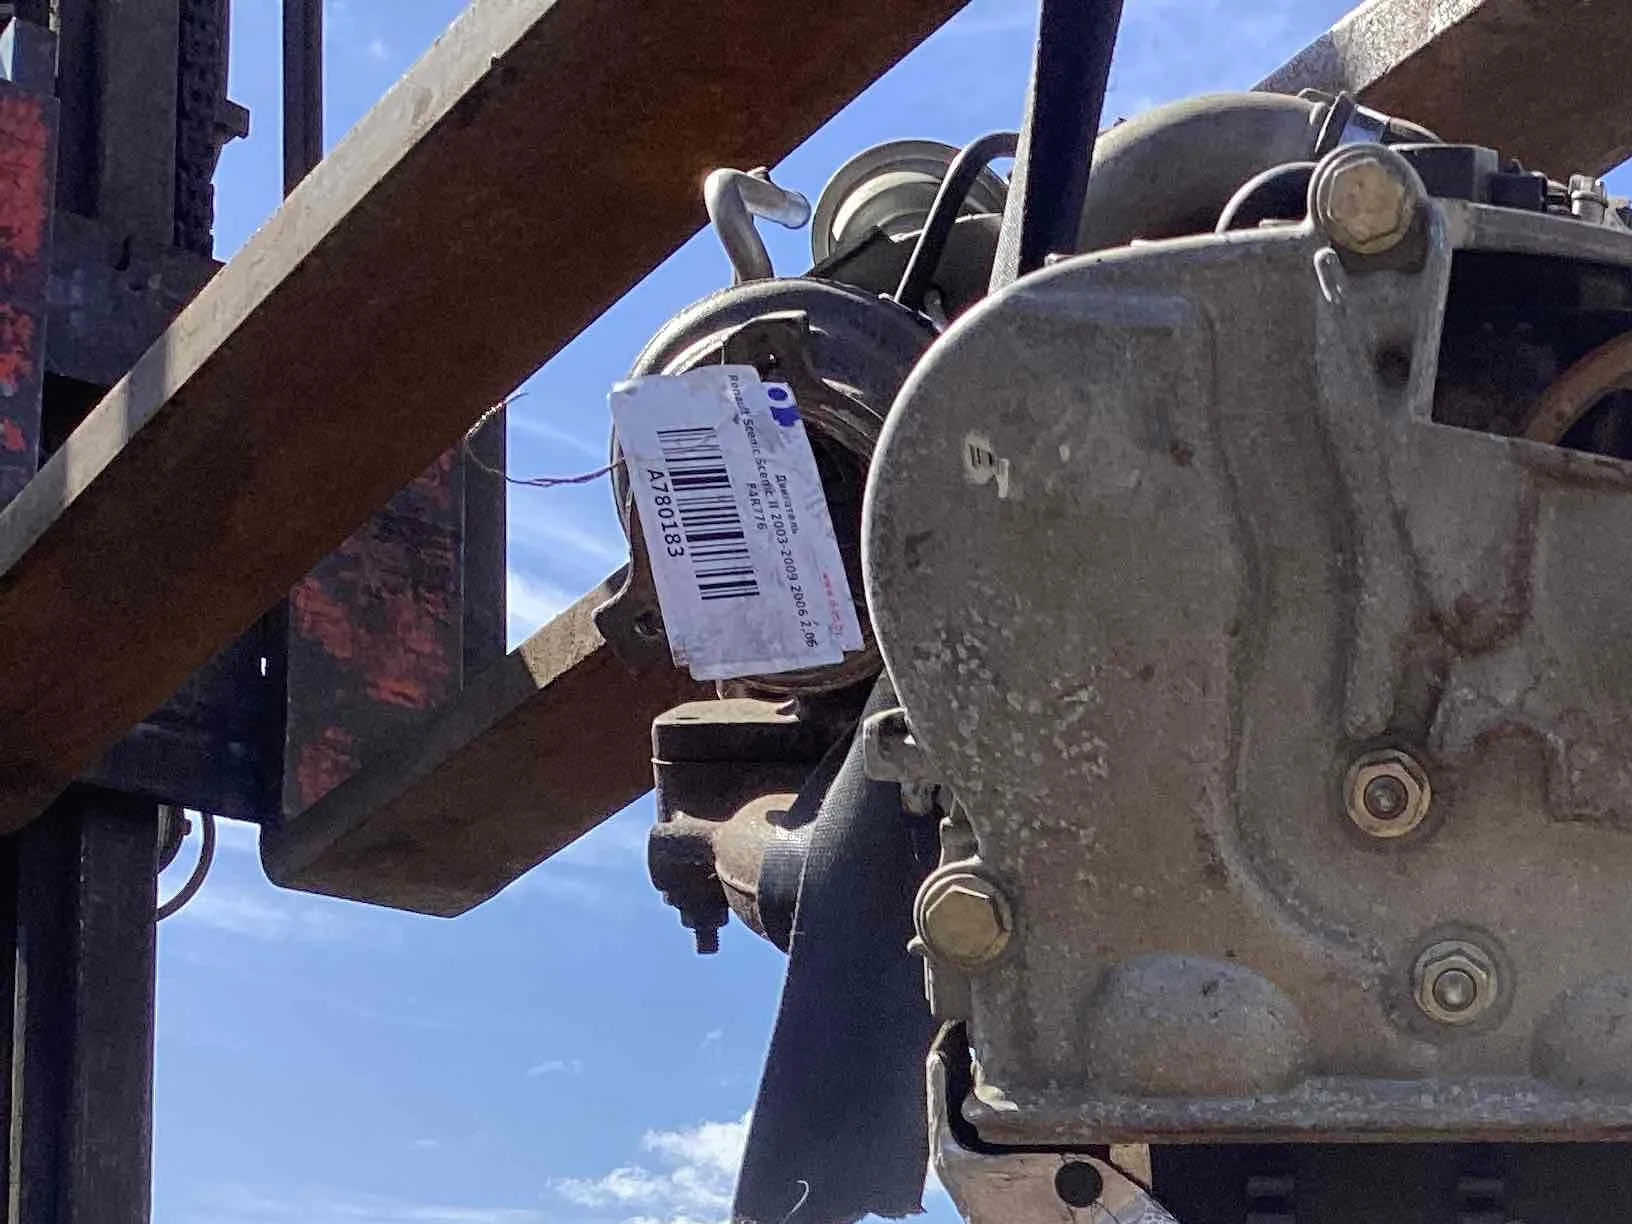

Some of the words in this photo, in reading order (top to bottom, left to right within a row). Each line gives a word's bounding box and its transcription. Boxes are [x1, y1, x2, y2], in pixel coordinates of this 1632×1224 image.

[647, 468, 685, 558] A780183
[742, 418, 761, 455] Scenic
[755, 458, 774, 497] Scenic
[770, 513, 798, 581] 2003-2009
[790, 583, 808, 617] 2006
